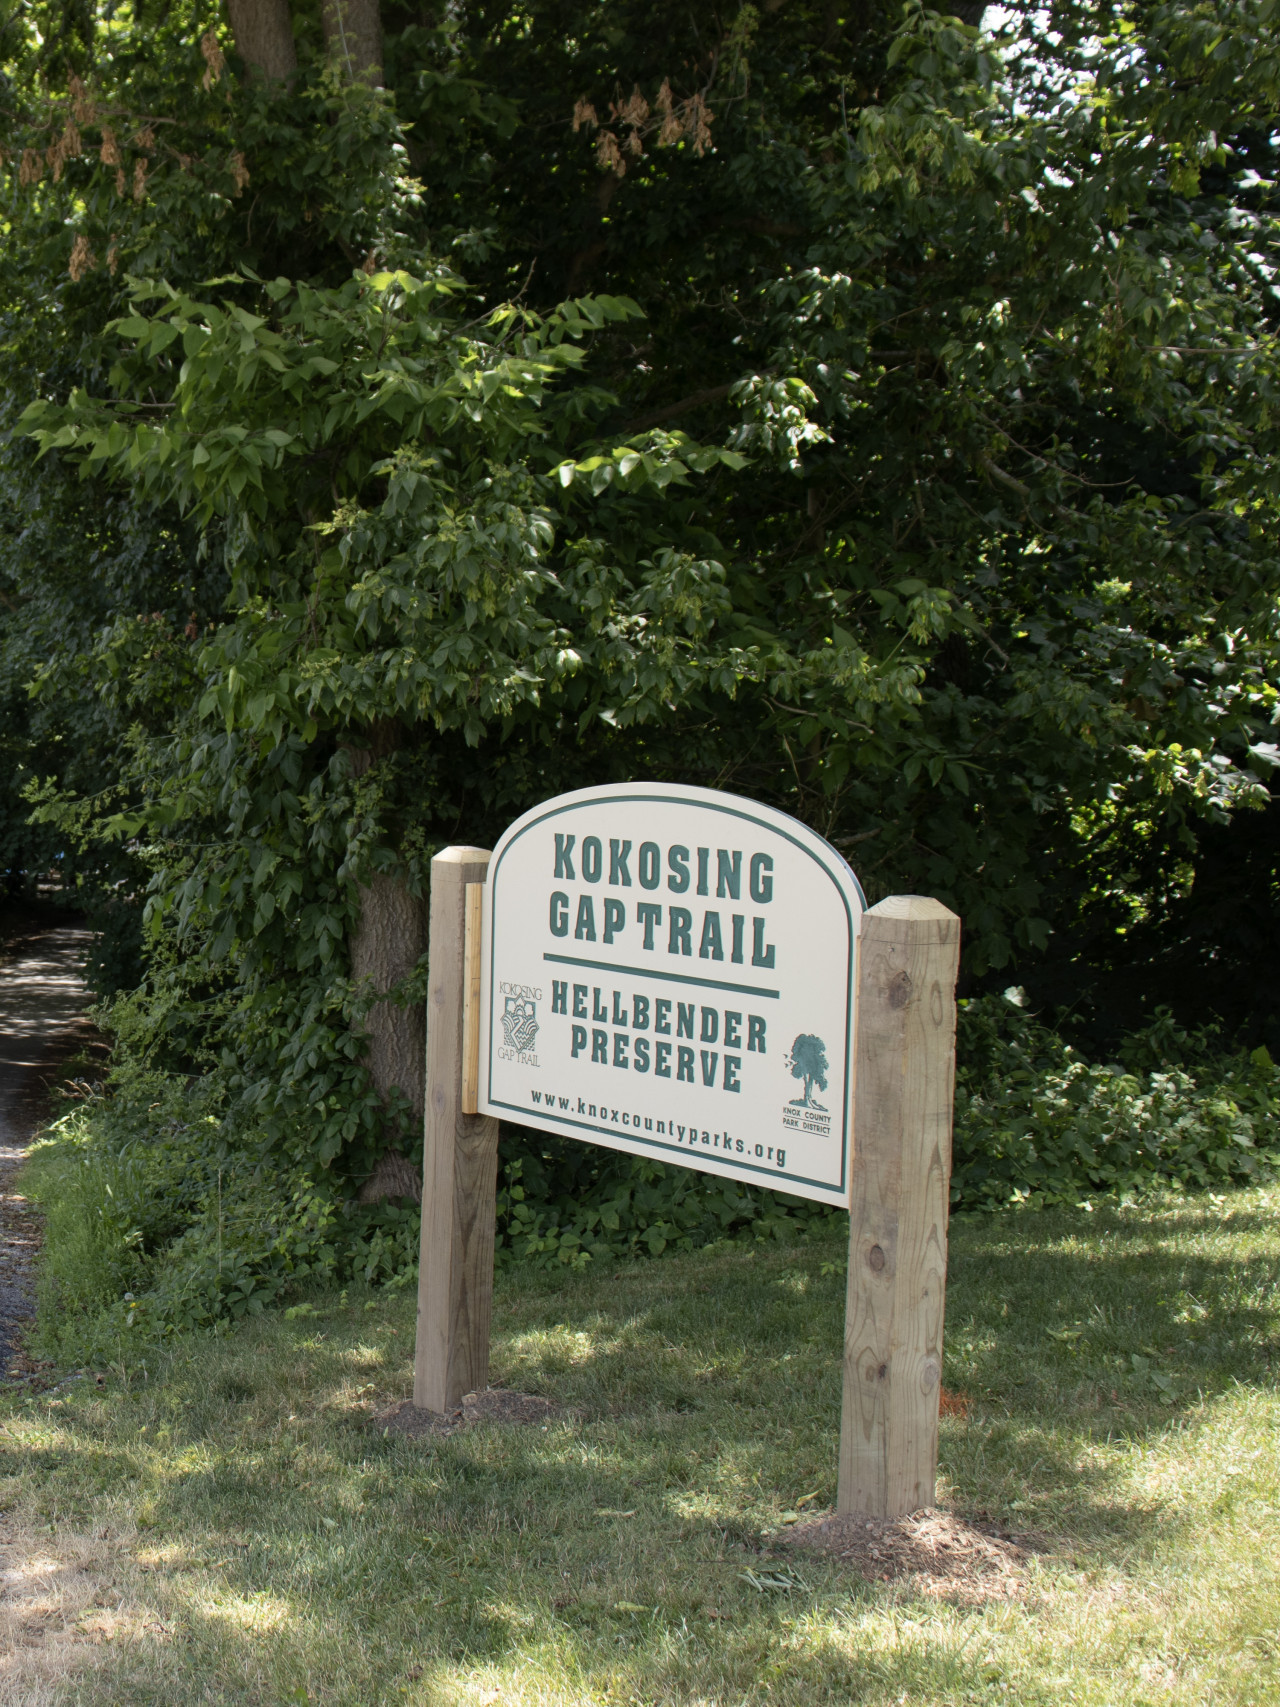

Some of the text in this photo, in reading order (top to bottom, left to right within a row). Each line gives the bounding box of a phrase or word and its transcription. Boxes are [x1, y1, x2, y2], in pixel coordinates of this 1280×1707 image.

[553, 832, 774, 904] KOKOSING
[549, 890, 776, 969] GAP TRAIL
[499, 981, 543, 1001] KOKOSING
[551, 980, 767, 1054] HELLBENDER
[497, 1046, 541, 1068] GAP TRAIL
[571, 1024, 742, 1093] PRESERVE
[531, 1089, 786, 1168] www.knoxcountyparks.org
[782, 1106, 831, 1123] KNOX COUNTY
[782, 1117, 831, 1134] PARK DISTRICT
